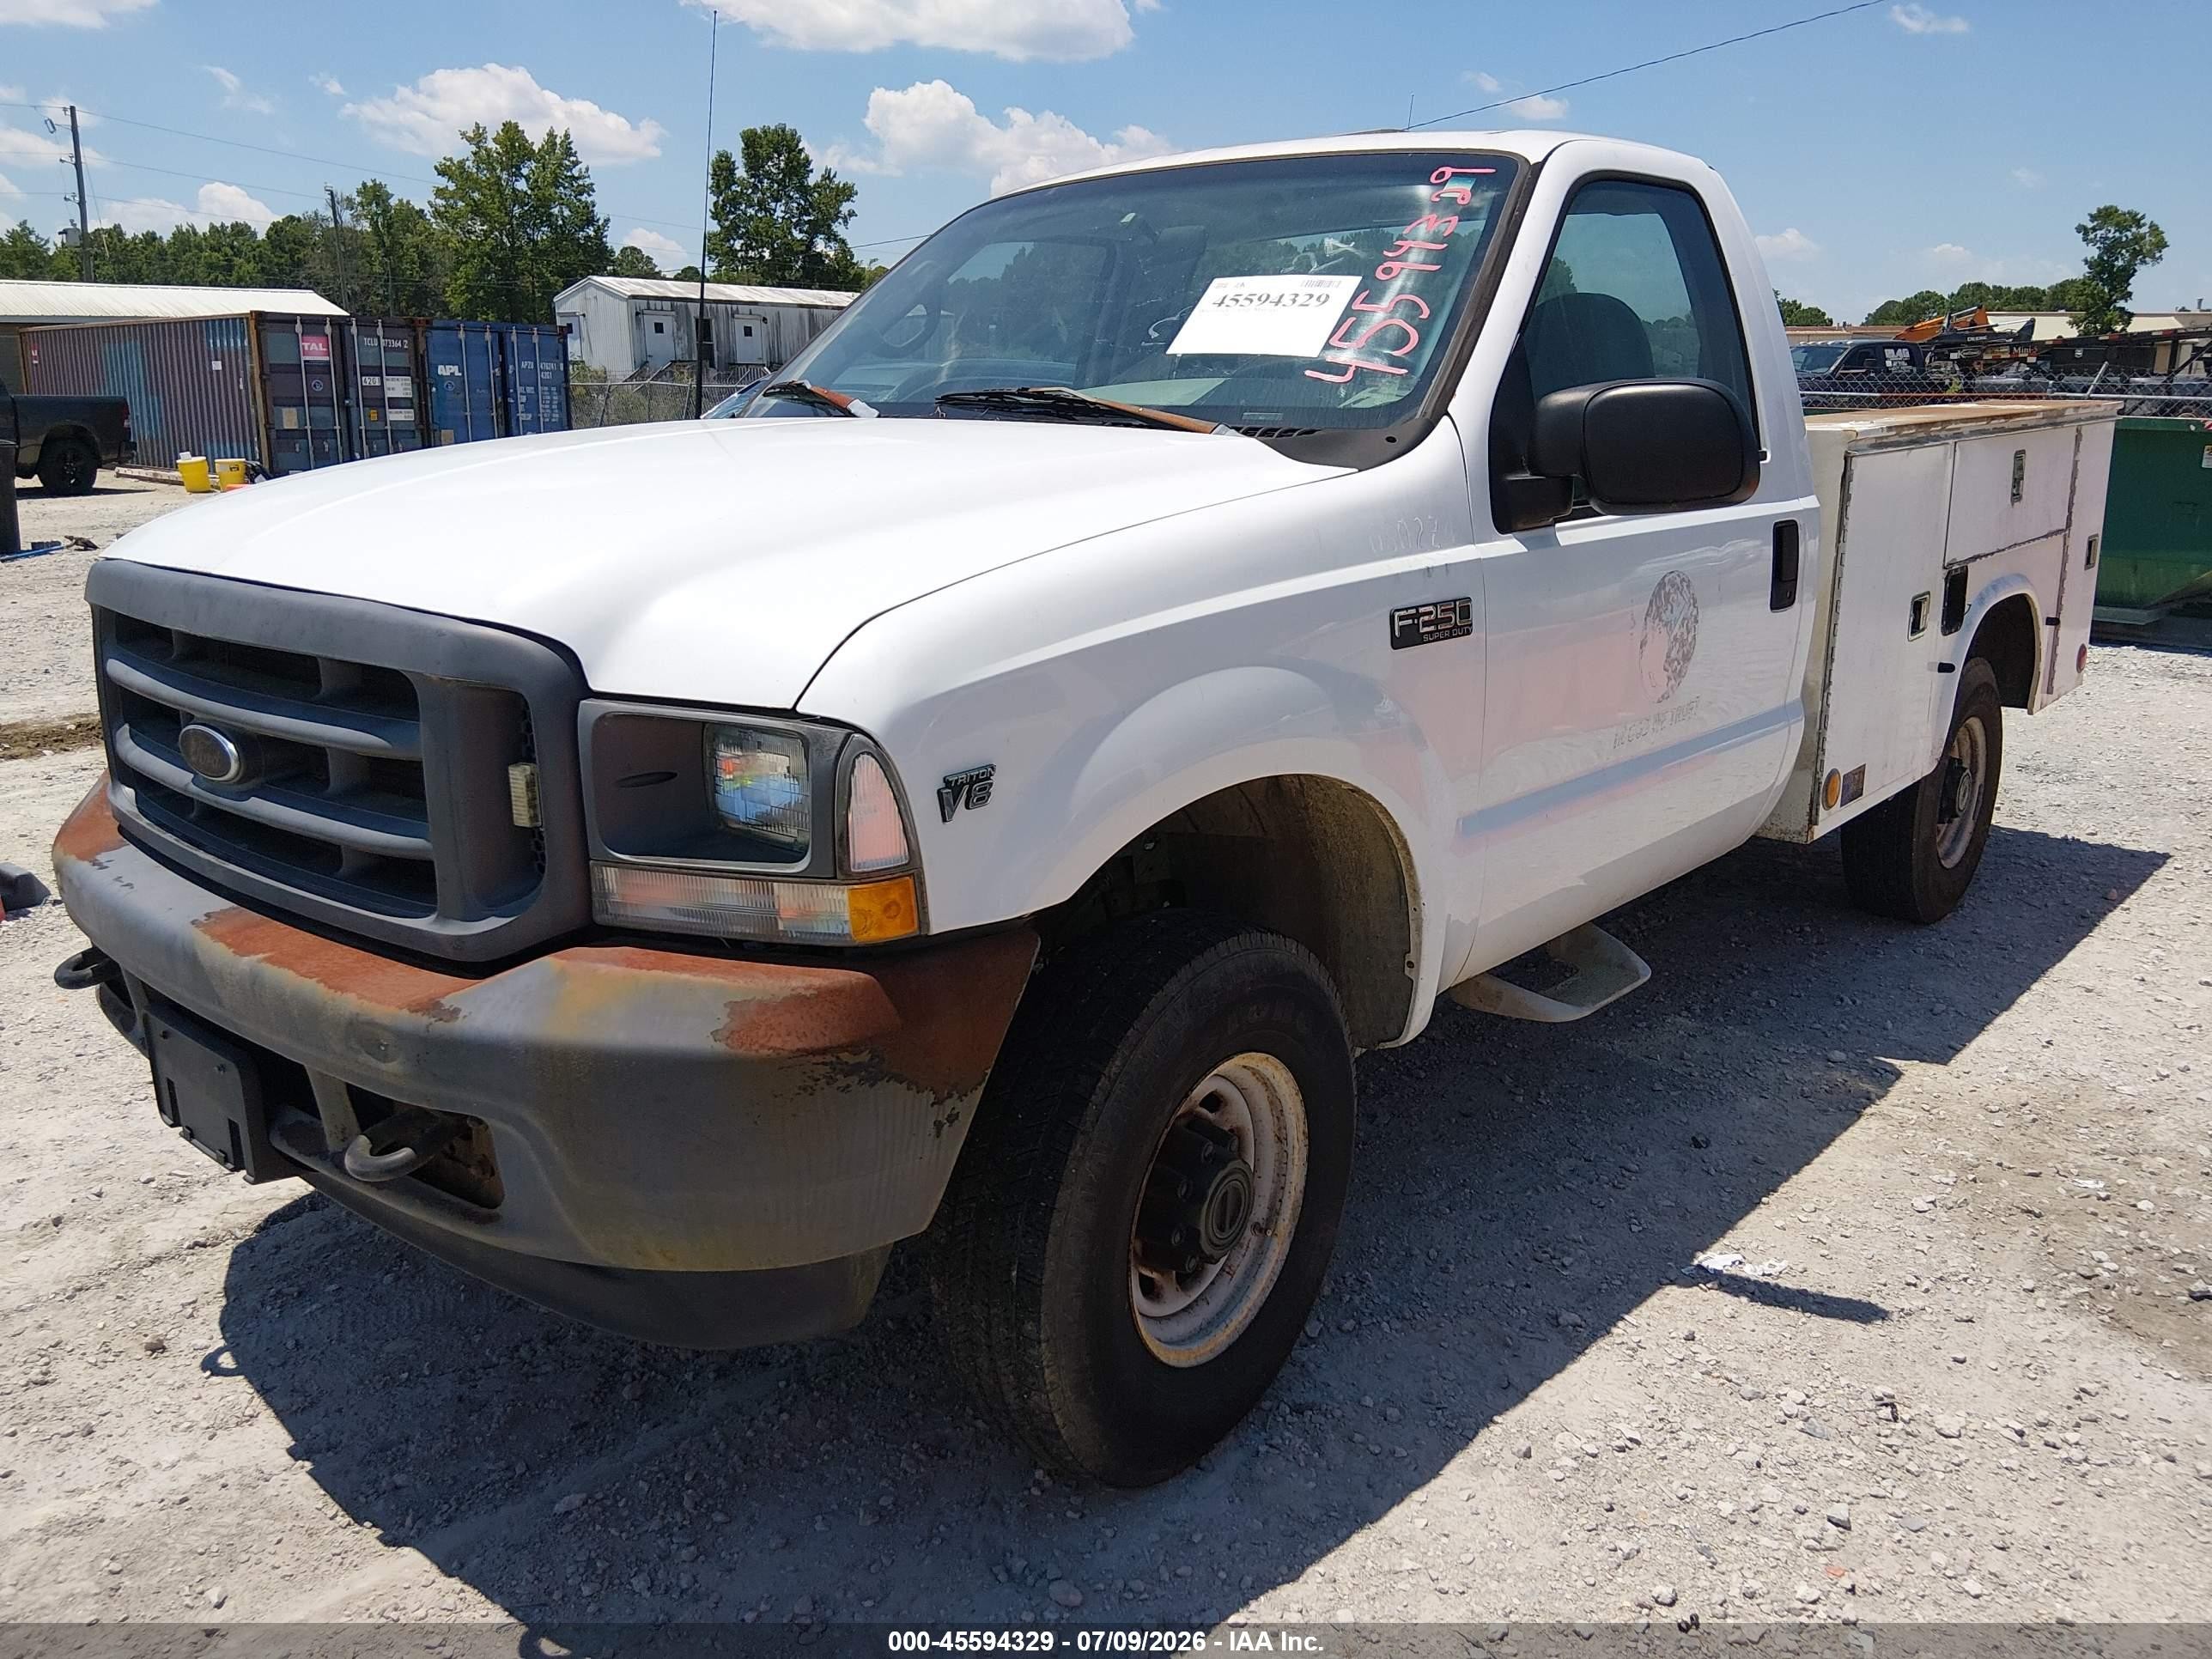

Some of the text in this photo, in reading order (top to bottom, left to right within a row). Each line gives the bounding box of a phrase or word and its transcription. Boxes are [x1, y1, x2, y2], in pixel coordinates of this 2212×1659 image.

[1304, 166, 1497, 383] 45594329
[1212, 292, 1330, 307] 45594329
[302, 343, 327, 351] TAL
[363, 337, 379, 347] TCLU
[437, 364, 462, 376] APL
[1423, 626, 1473, 642] SUPER DUTY
[947, 768, 995, 787] TRITON
[939, 780, 994, 822] V8
